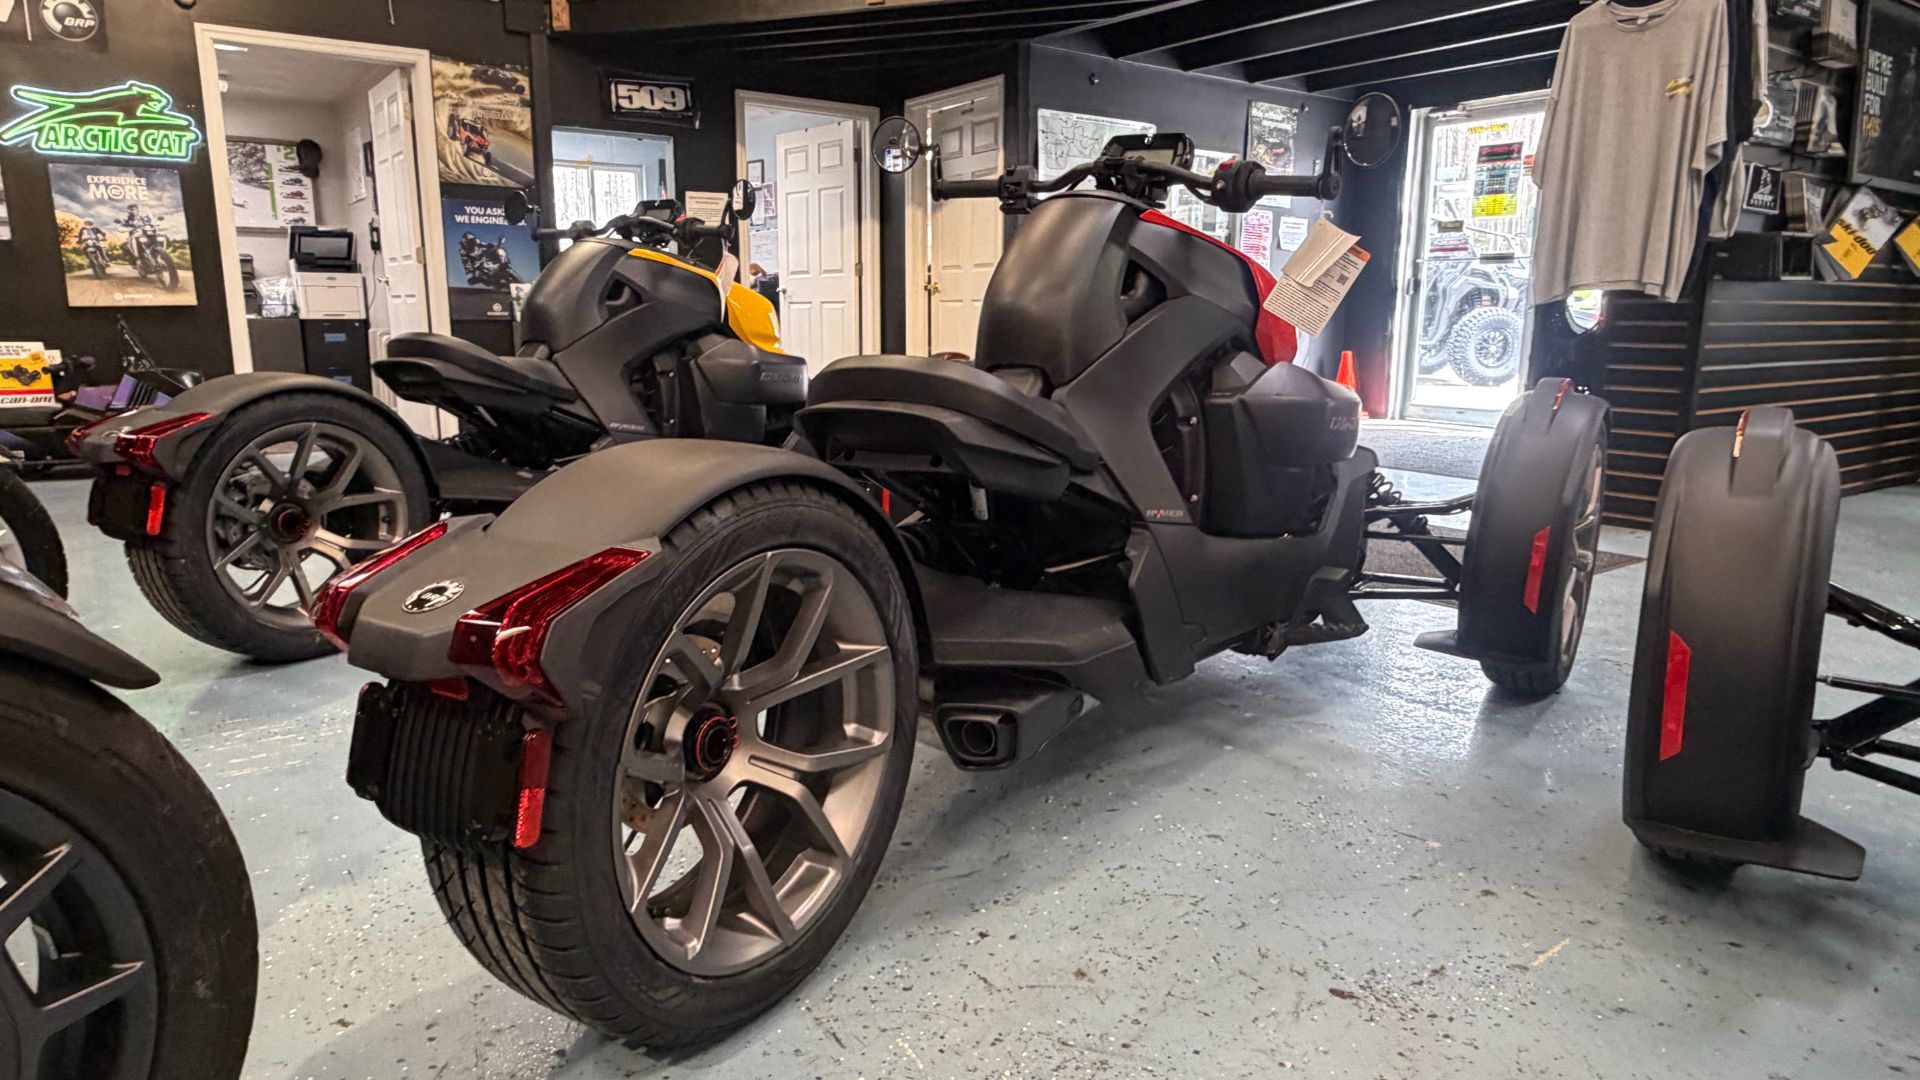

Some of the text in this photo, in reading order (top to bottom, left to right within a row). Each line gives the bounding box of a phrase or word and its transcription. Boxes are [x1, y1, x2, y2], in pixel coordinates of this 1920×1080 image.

[63, 16, 96, 29] BRP
[616, 83, 687, 112] 509
[39, 123, 192, 157] ARCTIC CAT
[86, 174, 147, 186] EXPERIENCE
[88, 184, 150, 201] MORE
[464, 205, 484, 216] YOU
[454, 214, 470, 224] WE
